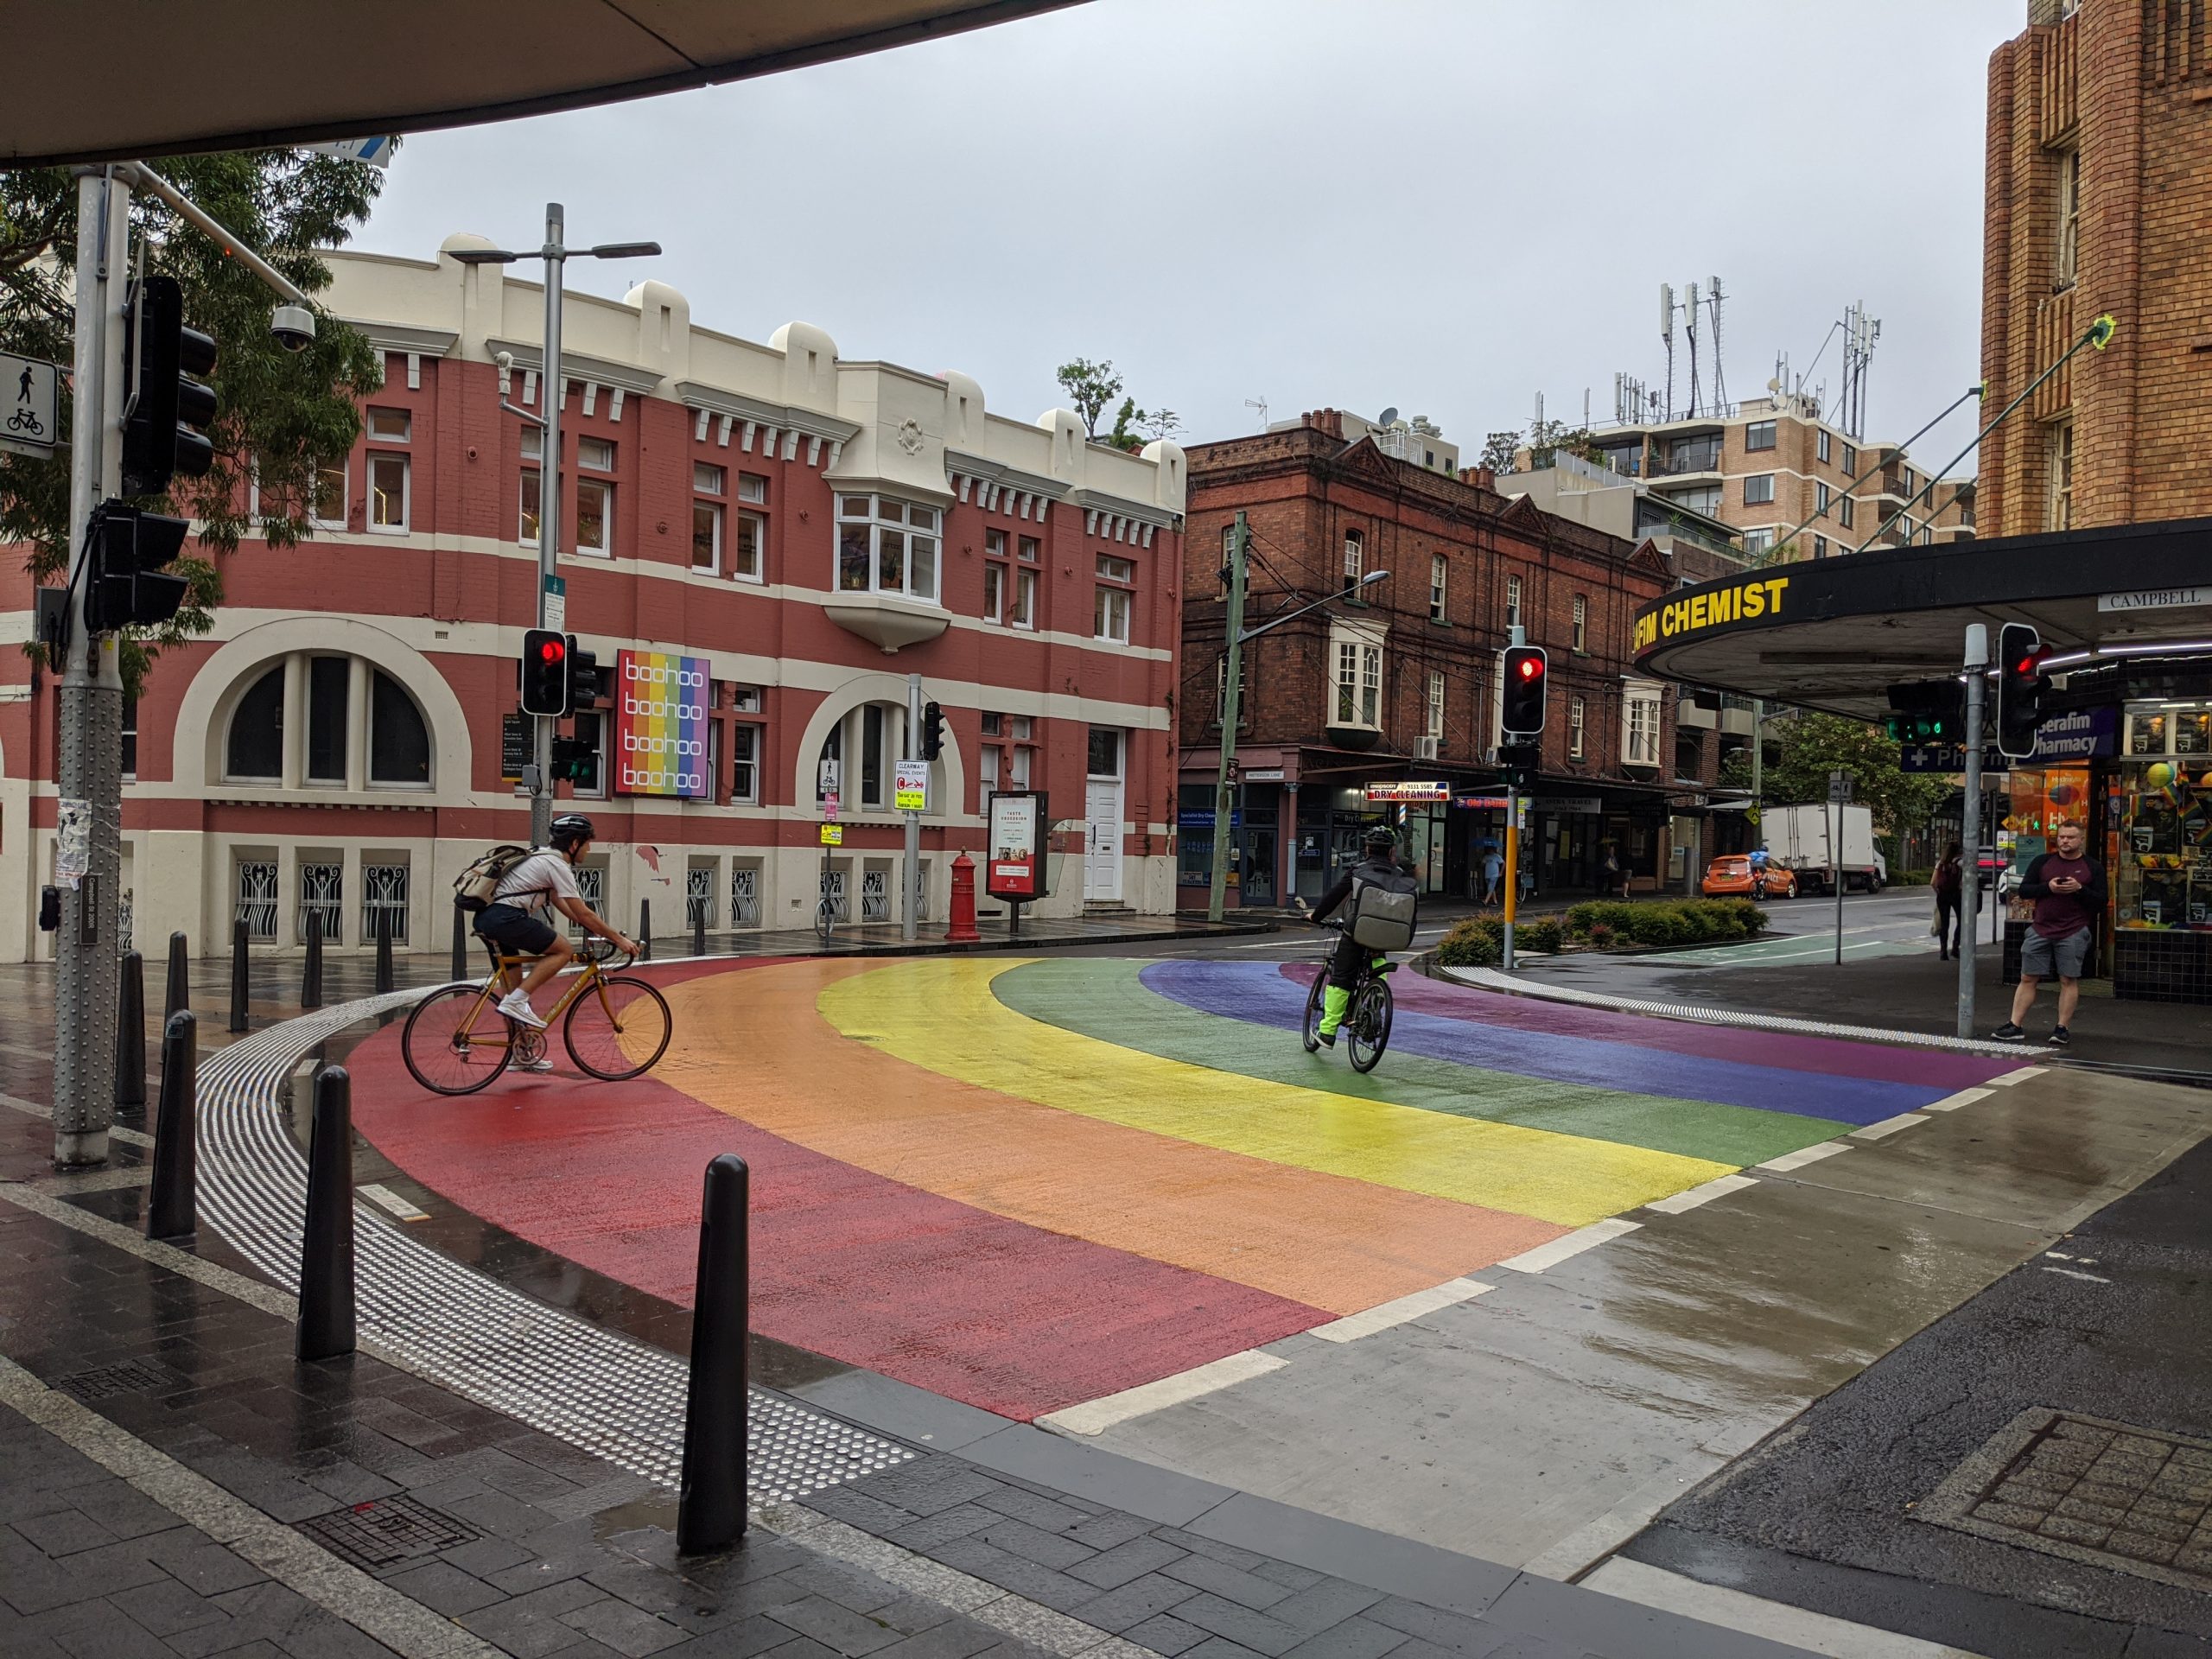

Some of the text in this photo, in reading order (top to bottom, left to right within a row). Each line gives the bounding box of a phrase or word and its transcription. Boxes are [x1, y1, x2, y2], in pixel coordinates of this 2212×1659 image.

[1662, 577, 1789, 637] CHEMIST
[2110, 590, 2201, 608] CAMPBELL
[626, 657, 703, 688] boohoo
[625, 691, 702, 721] boohoo
[624, 728, 702, 756] boohoo
[2036, 735, 2098, 755] harmacy
[1937, 749, 2009, 766] Phrm
[623, 762, 701, 789] boohoo
[1374, 790, 1440, 799] DRY CLEANING
[1484, 798, 1508, 808] BARB
